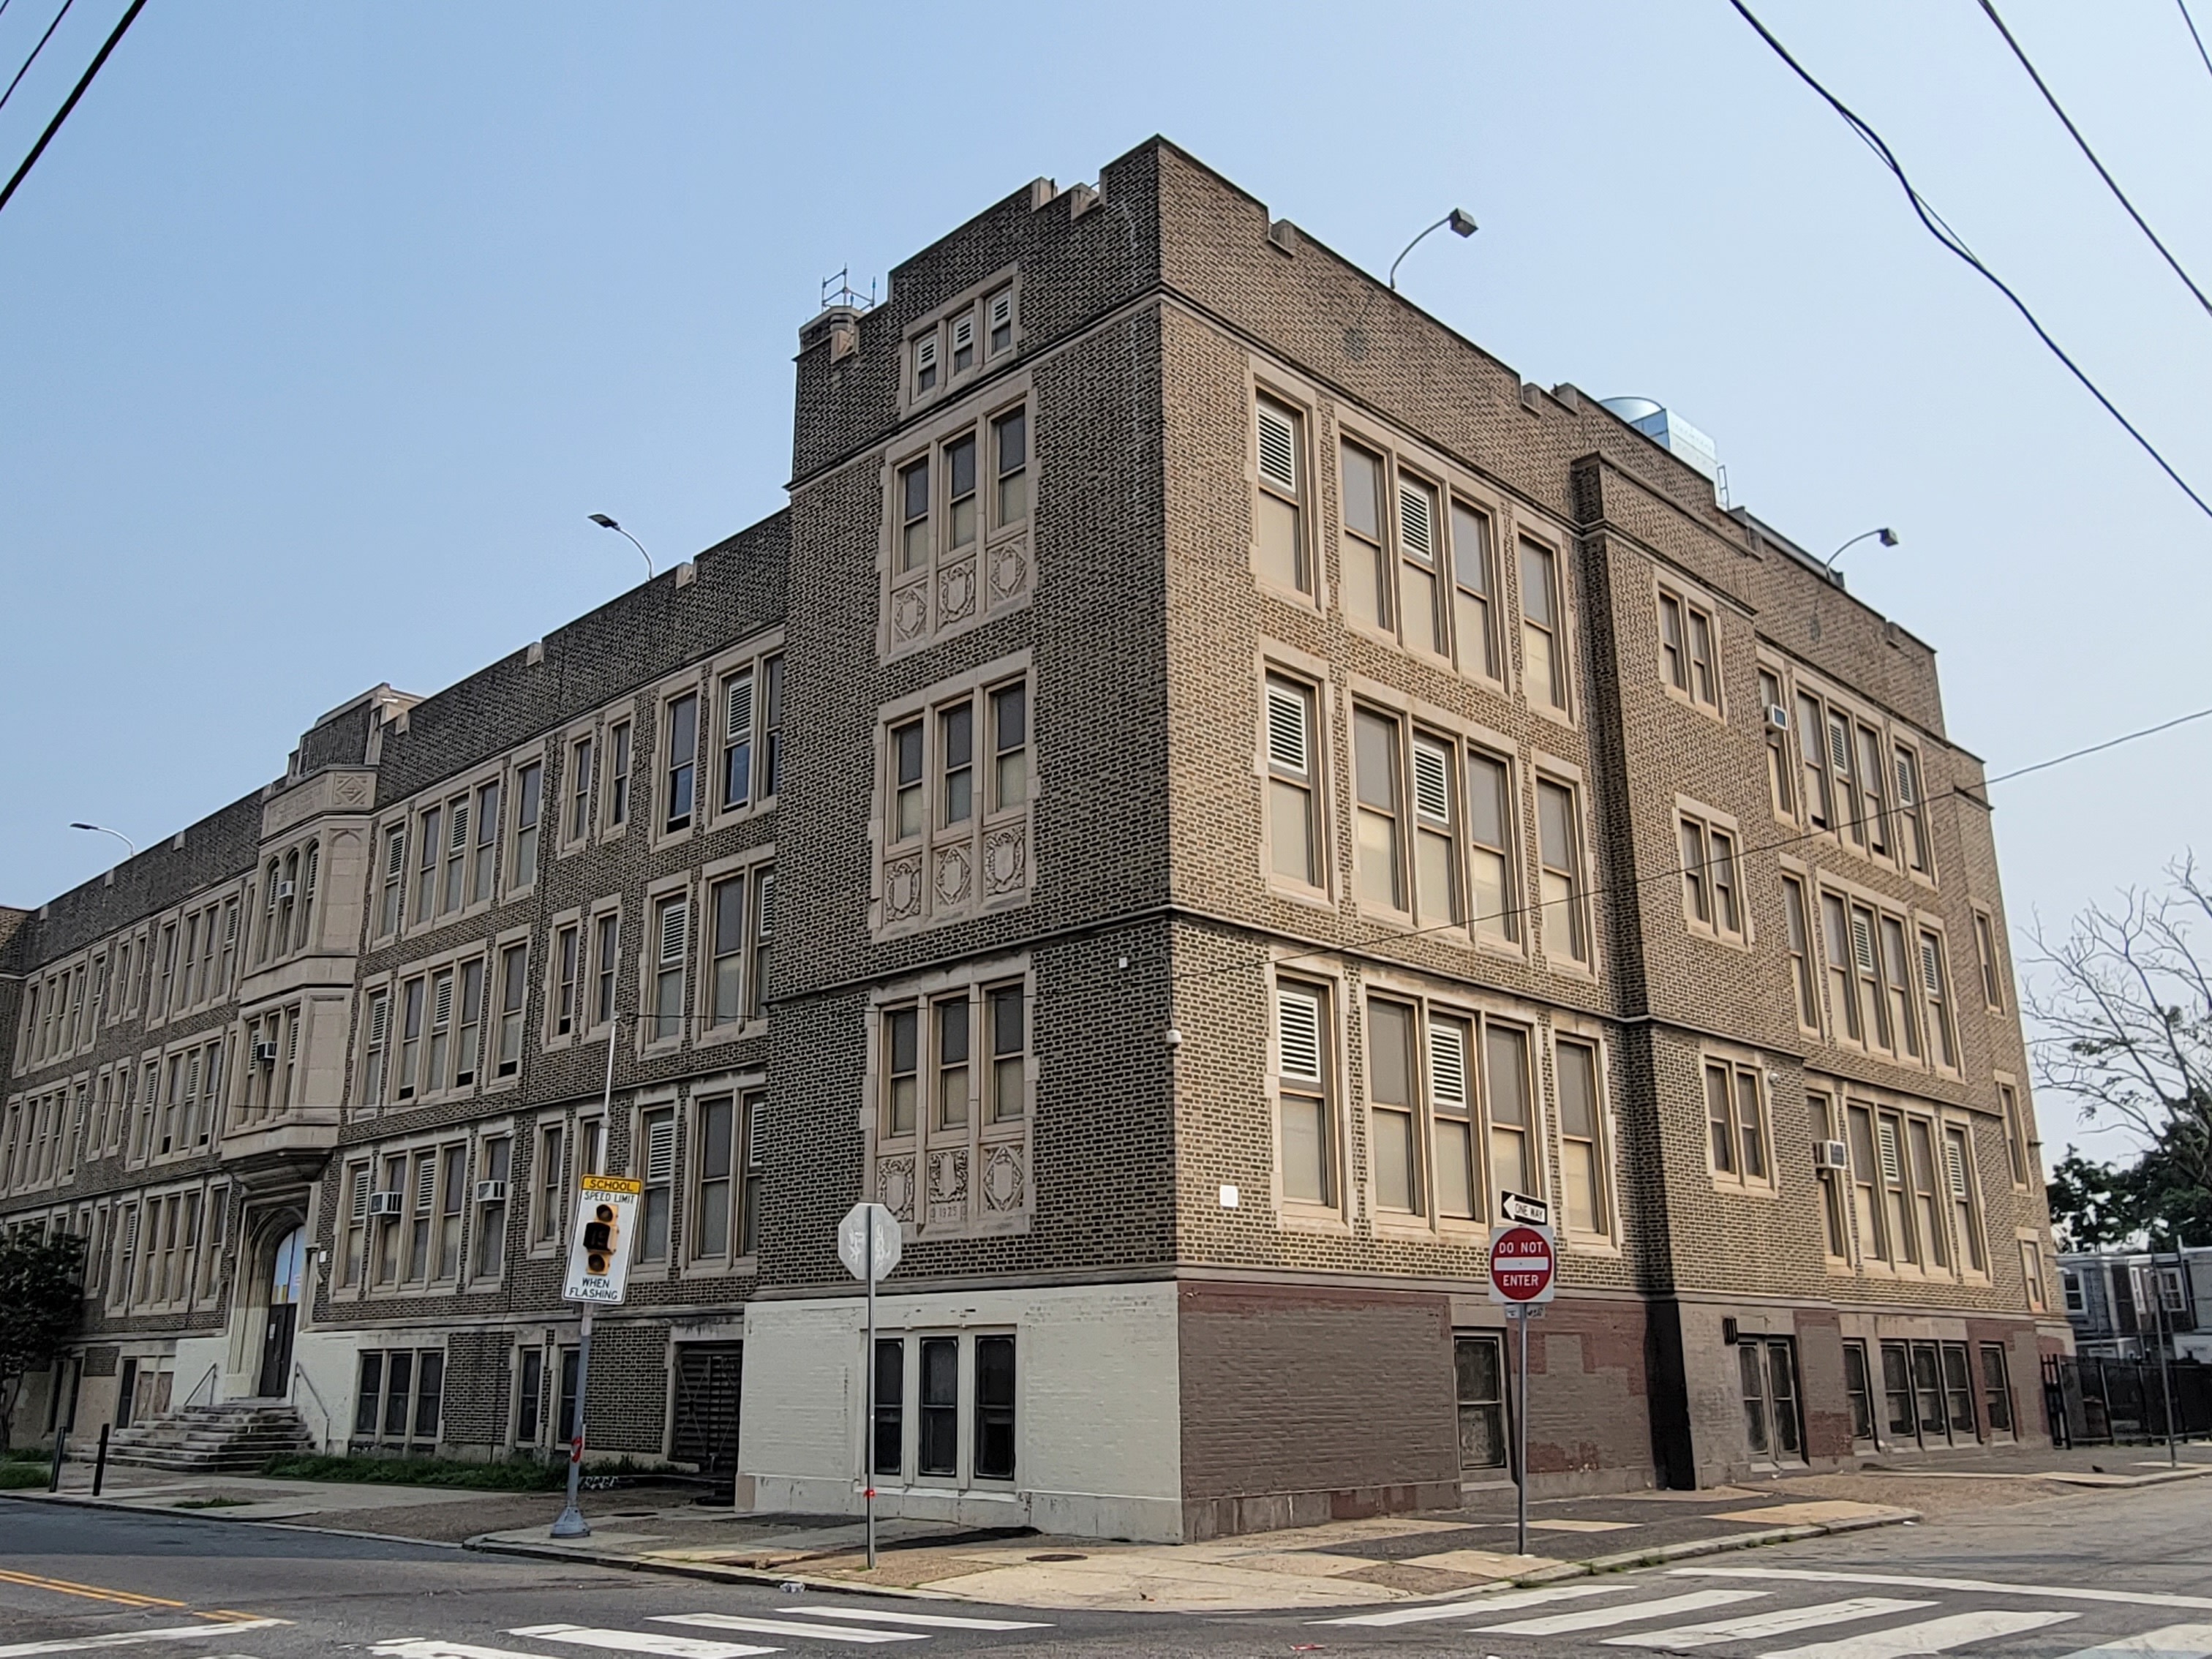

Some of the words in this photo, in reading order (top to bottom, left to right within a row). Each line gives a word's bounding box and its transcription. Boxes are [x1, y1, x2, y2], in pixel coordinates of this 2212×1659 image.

[590, 1179, 633, 1191] SCHOOL
[584, 1192, 612, 1202] SPEED
[614, 1195, 635, 1204] LIMIT
[1514, 1203, 1528, 1216] ONE
[1530, 1207, 1543, 1220] WAY
[1499, 1242, 1514, 1254] DO
[1521, 1241, 1543, 1254] NOT
[582, 1278, 610, 1288] WHEN
[1503, 1275, 1539, 1286] ENTER
[569, 1287, 618, 1300] FLASHING
